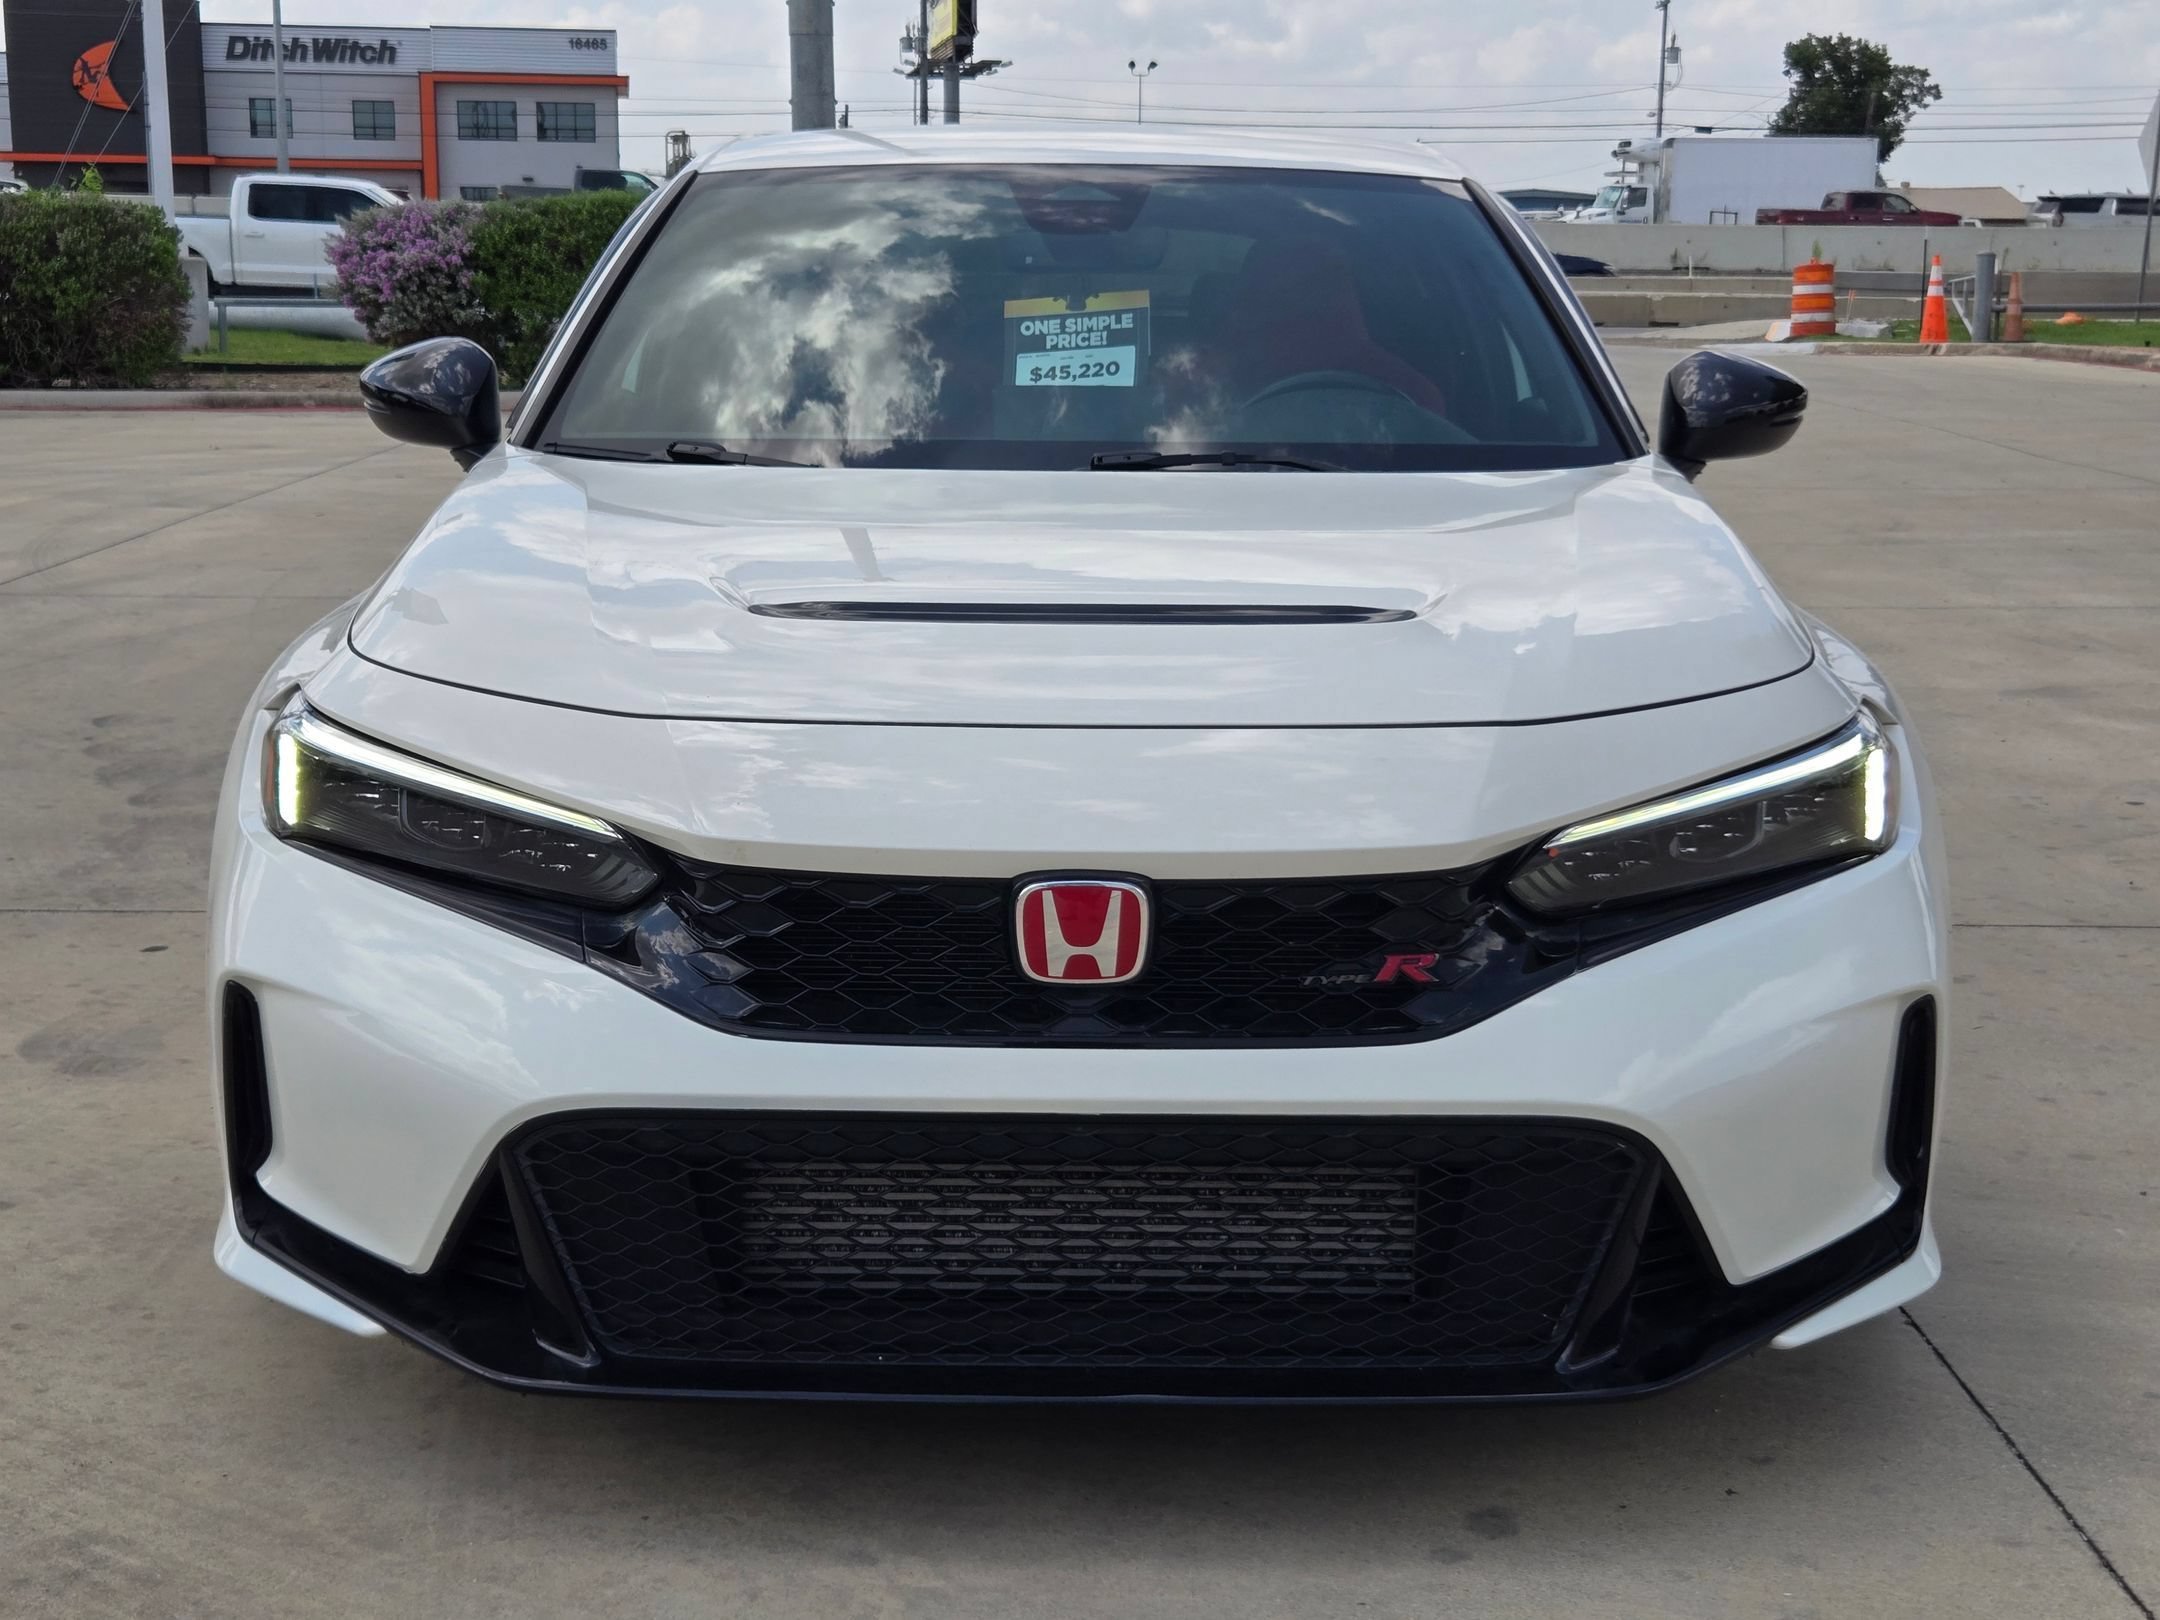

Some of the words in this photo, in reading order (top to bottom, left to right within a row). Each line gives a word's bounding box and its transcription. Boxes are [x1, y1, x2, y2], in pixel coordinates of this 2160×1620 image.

[312, 37, 397, 65] Witch
[1020, 318, 1061, 336] ONE
[1065, 313, 1134, 333] SIMPLE
[1046, 331, 1108, 349] PRICE!
[1030, 361, 1120, 383] $45,220
[1303, 974, 1370, 986] TYPE
[1374, 953, 1440, 983] R
